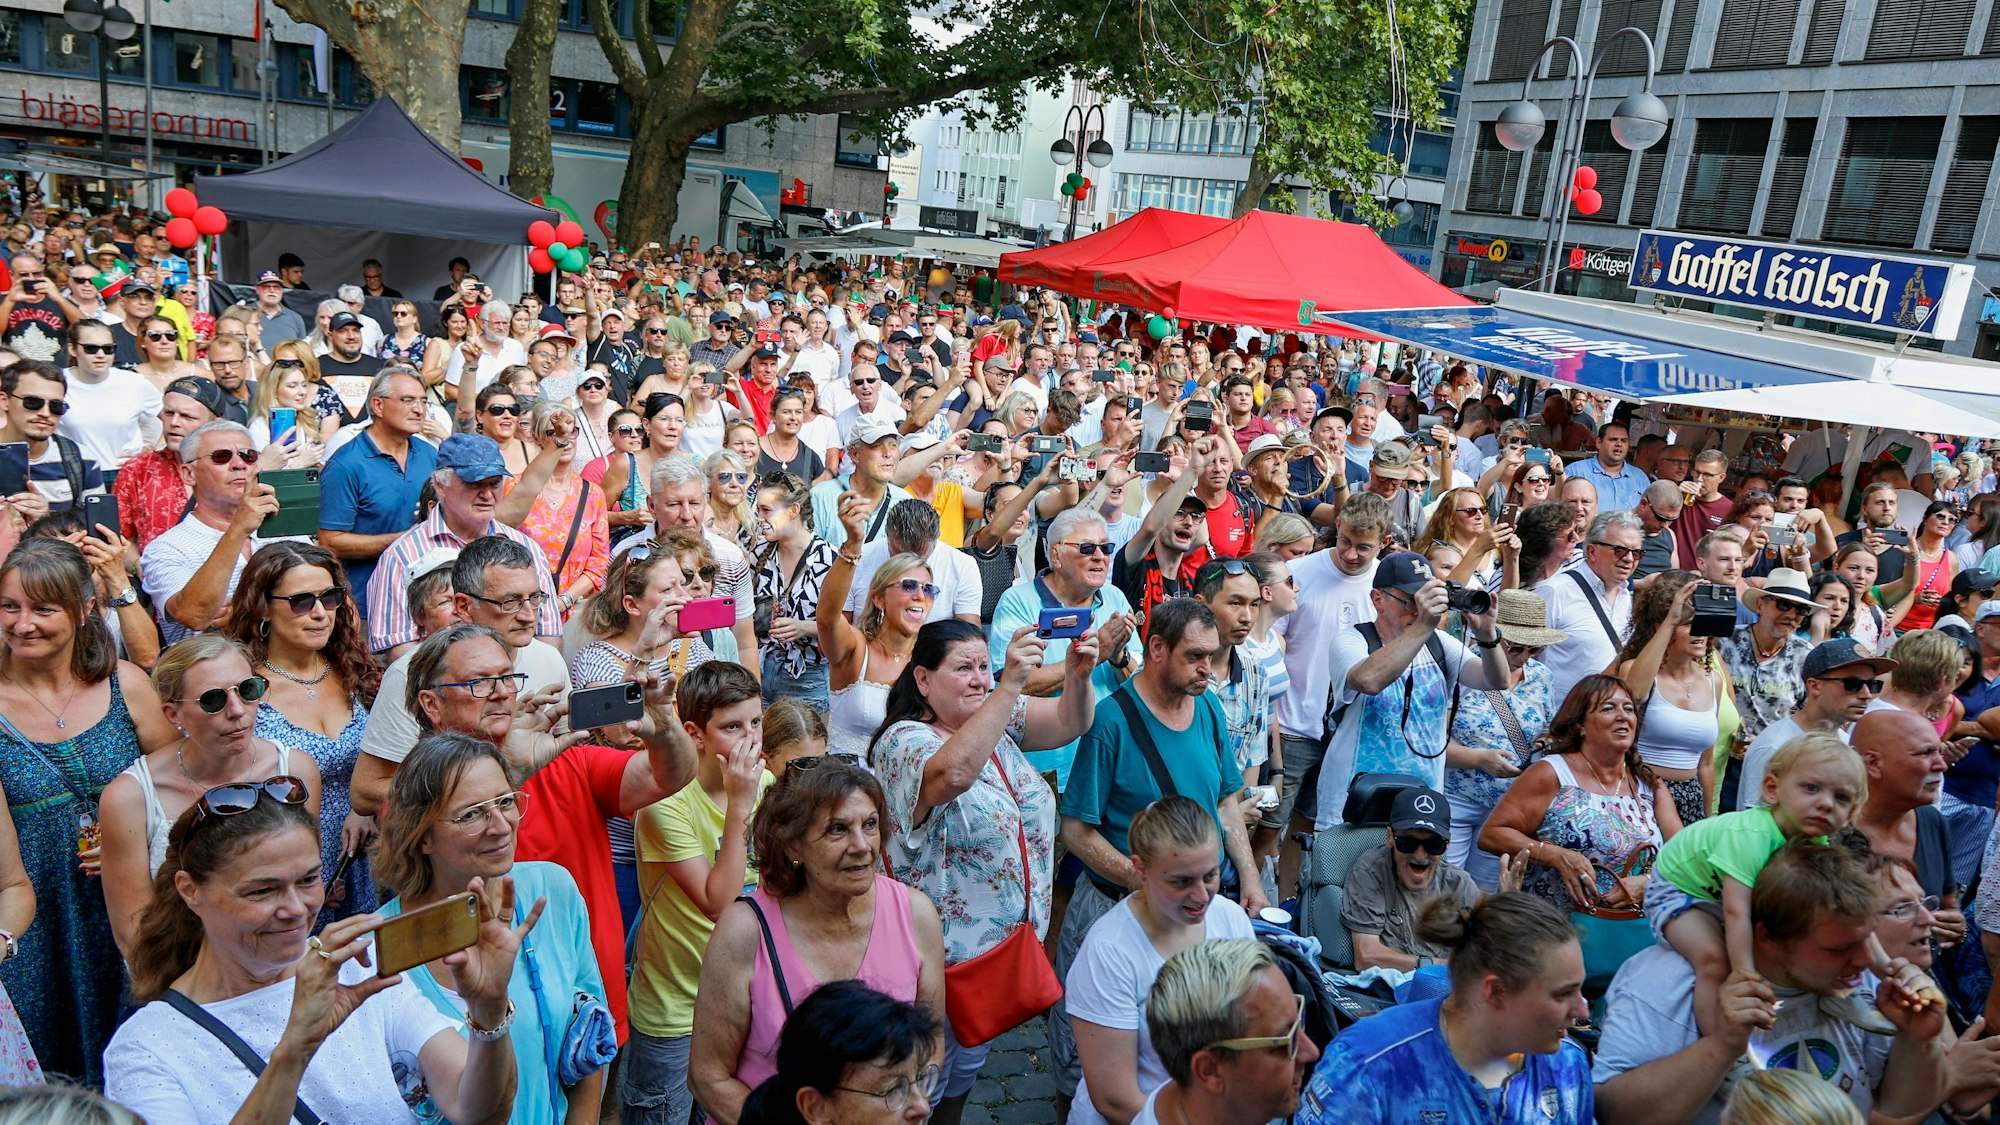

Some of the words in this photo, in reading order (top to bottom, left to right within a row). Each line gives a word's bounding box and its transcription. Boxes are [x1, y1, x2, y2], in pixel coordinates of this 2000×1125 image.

[1456, 238, 1489, 258] Kamps
[1586, 252, 1632, 277] Köttgen
[1667, 239, 1764, 297] Gaffel
[1763, 251, 1891, 324] Kölsch
